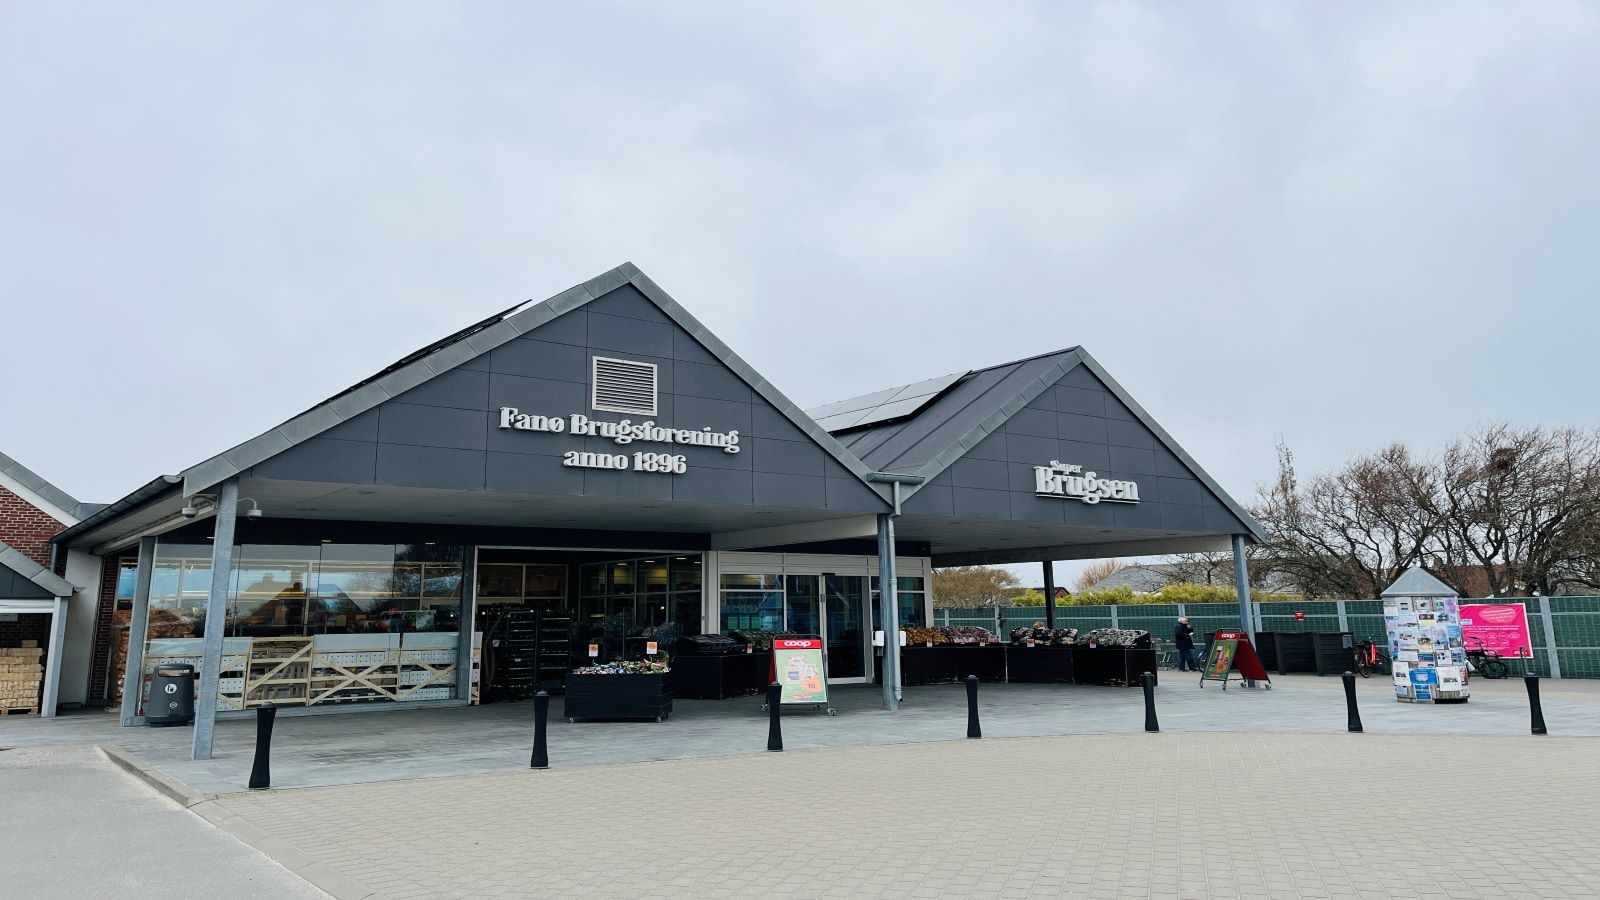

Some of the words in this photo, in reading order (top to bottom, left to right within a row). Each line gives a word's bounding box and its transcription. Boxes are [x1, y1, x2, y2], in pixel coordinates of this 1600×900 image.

[499, 406, 565, 433] Fanø
[569, 414, 741, 454] Brugsforening
[563, 450, 629, 470] anno
[632, 451, 687, 474] 1896
[1049, 460, 1083, 475] Super
[1033, 465, 1141, 504] Brugsen
[783, 640, 812, 648] coop
